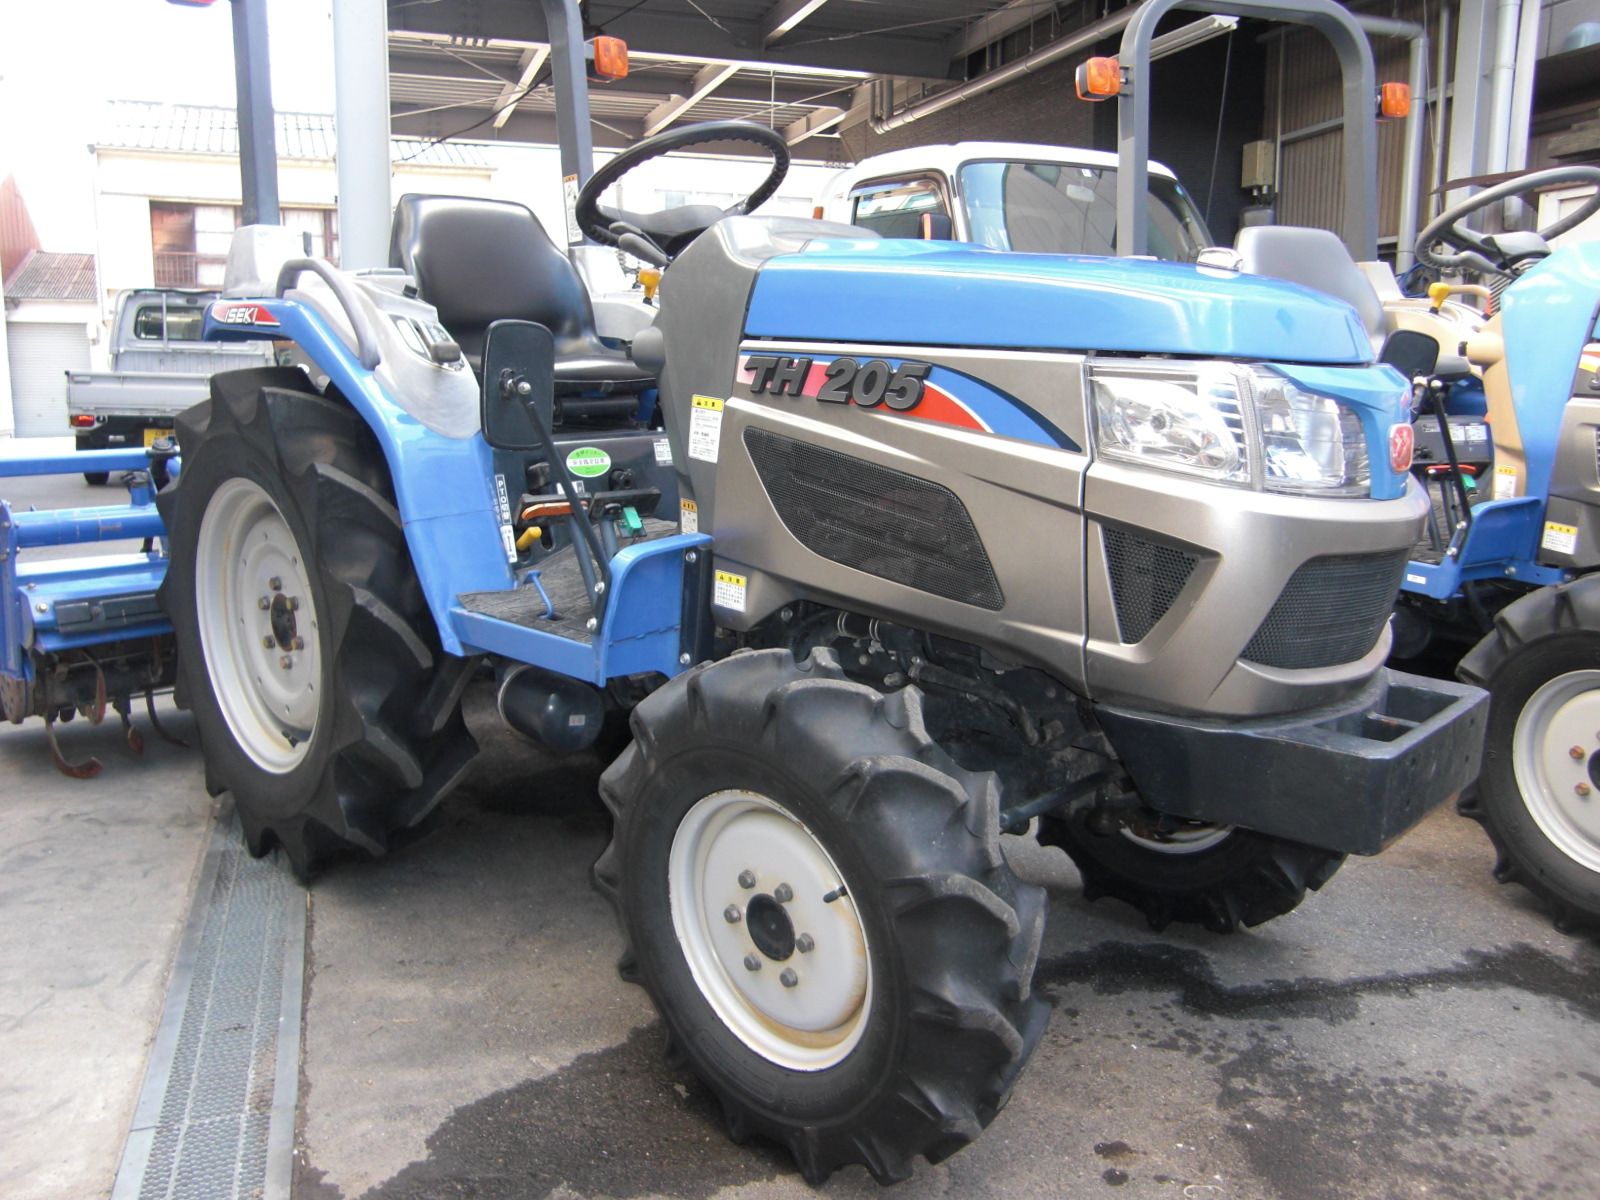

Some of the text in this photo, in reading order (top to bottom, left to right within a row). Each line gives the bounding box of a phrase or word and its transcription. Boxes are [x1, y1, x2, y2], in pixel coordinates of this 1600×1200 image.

[224, 307, 259, 324] ISEKI
[744, 355, 932, 412] TH 205
